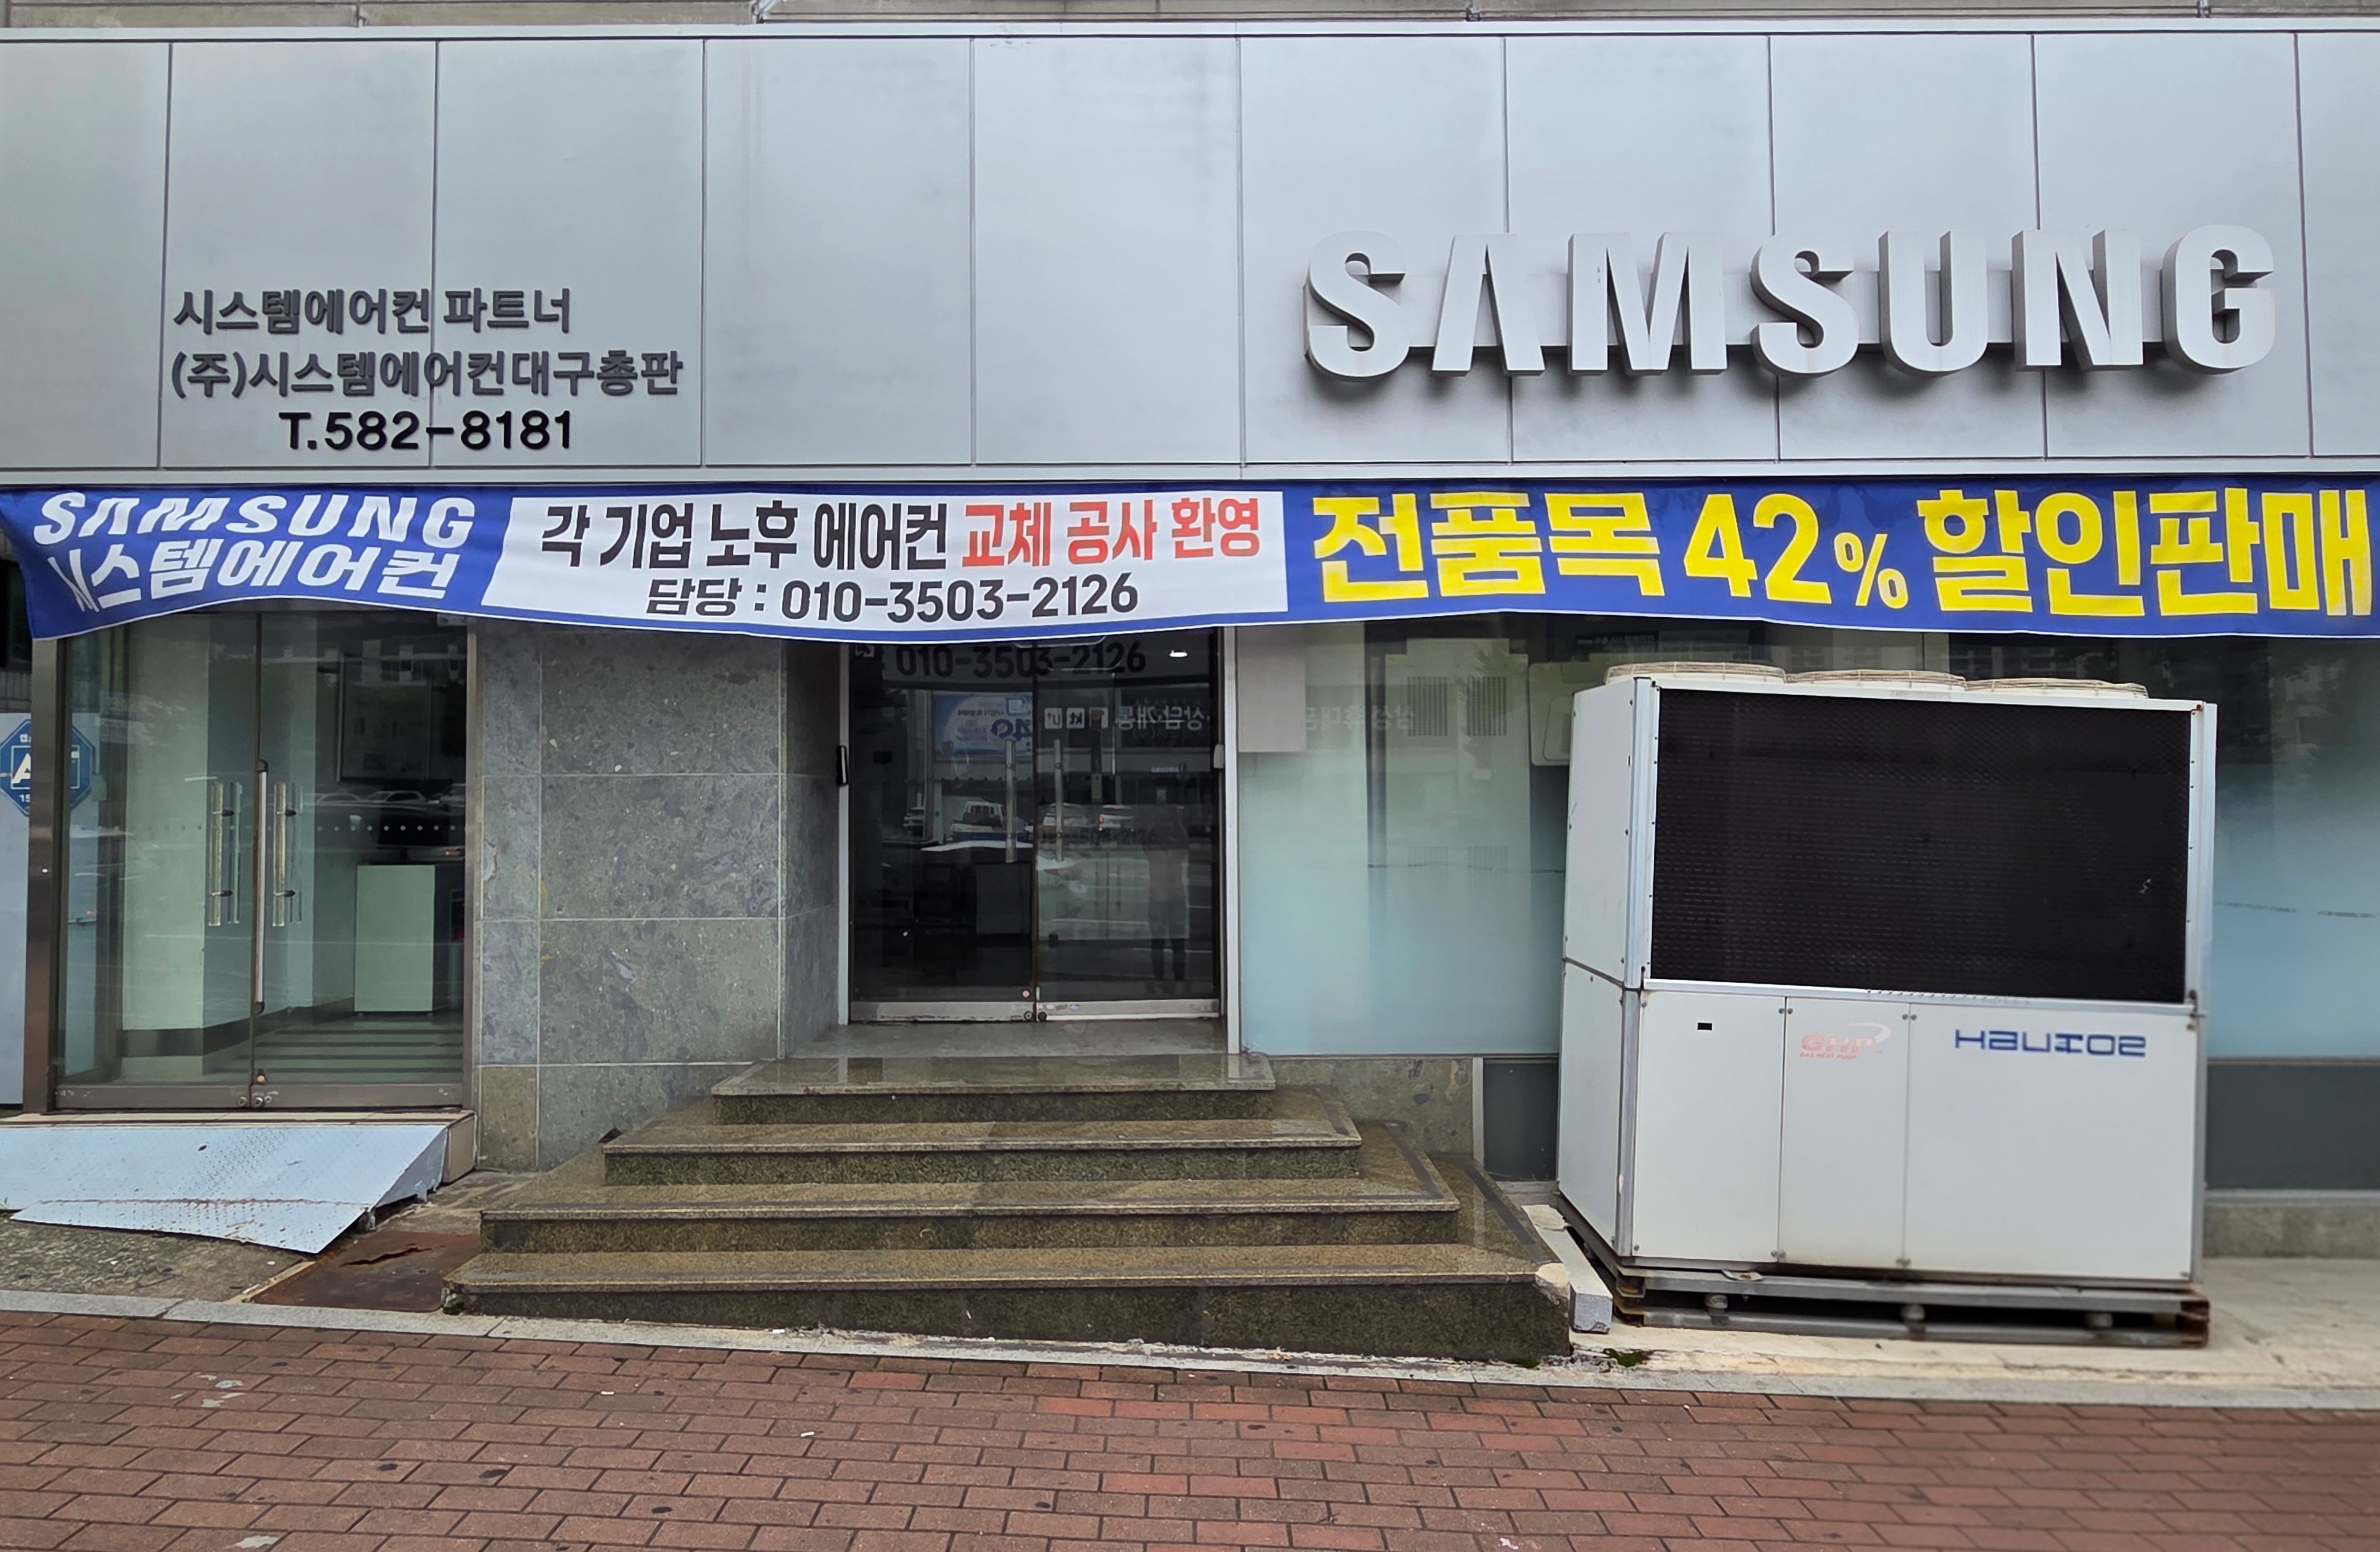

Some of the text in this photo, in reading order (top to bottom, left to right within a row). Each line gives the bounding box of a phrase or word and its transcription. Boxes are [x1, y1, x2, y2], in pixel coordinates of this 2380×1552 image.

[173, 287, 570, 334] 시스템에어컨 파트너
[1308, 225, 2275, 378] SAMSUNG
[171, 349, 684, 398] (주)시스템에어컨대구총판
[278, 410, 572, 450] T.582-8181
[33, 492, 475, 548] SAMSUNG
[541, 497, 1260, 571] 각 기업 노후 에어컨 교체 공사 환영
[1313, 491, 1665, 603] 전품목
[1916, 487, 2372, 617] 할인판매
[646, 578, 743, 616] 담당
[781, 571, 1139, 623] 010-3503-2126
